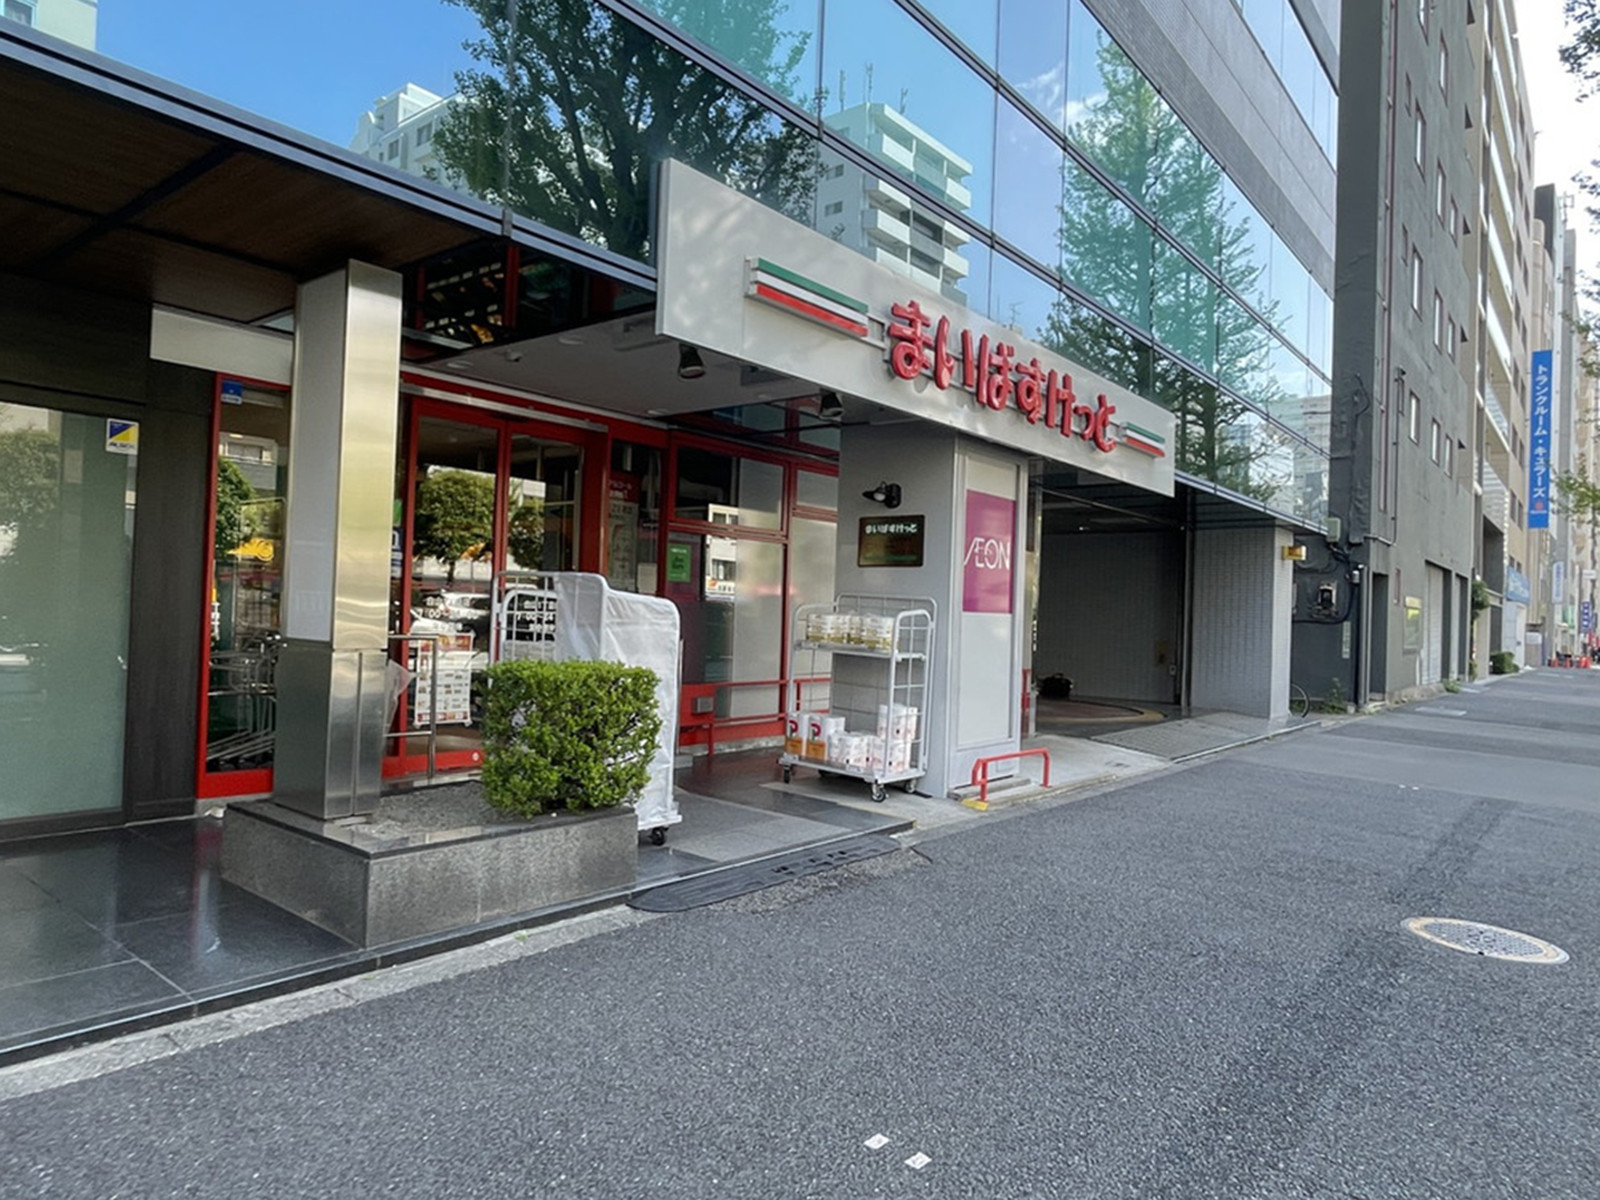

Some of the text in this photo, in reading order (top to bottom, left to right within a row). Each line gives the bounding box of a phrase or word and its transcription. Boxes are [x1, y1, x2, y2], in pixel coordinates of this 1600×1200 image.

[888, 300, 1117, 453] まいばすけっと
[1533, 364, 1549, 498] トランクルーム・キュラーズ
